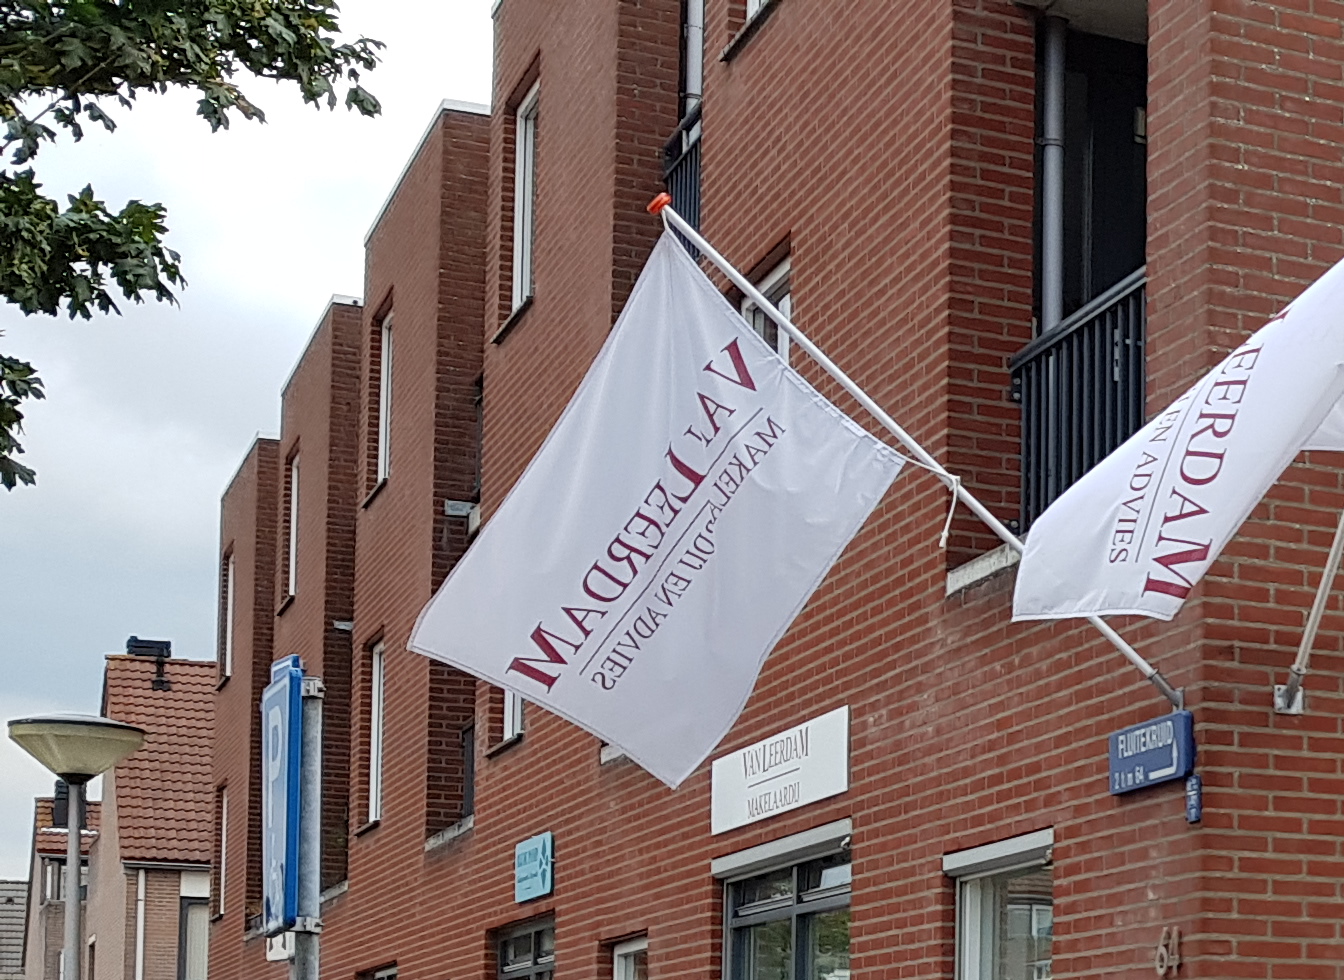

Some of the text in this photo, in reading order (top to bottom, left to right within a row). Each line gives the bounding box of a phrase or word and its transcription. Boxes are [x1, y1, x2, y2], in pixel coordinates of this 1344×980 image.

[1142, 307, 1291, 600] EERDAM
[1109, 409, 1181, 565] EN ADVIES
[267, 705, 283, 829] P
[742, 726, 810, 779] VAN LEERDAM
[1134, 764, 1145, 785] 64
[747, 782, 800, 819] MAKELAARDIJ
[1155, 926, 1181, 976] 64
